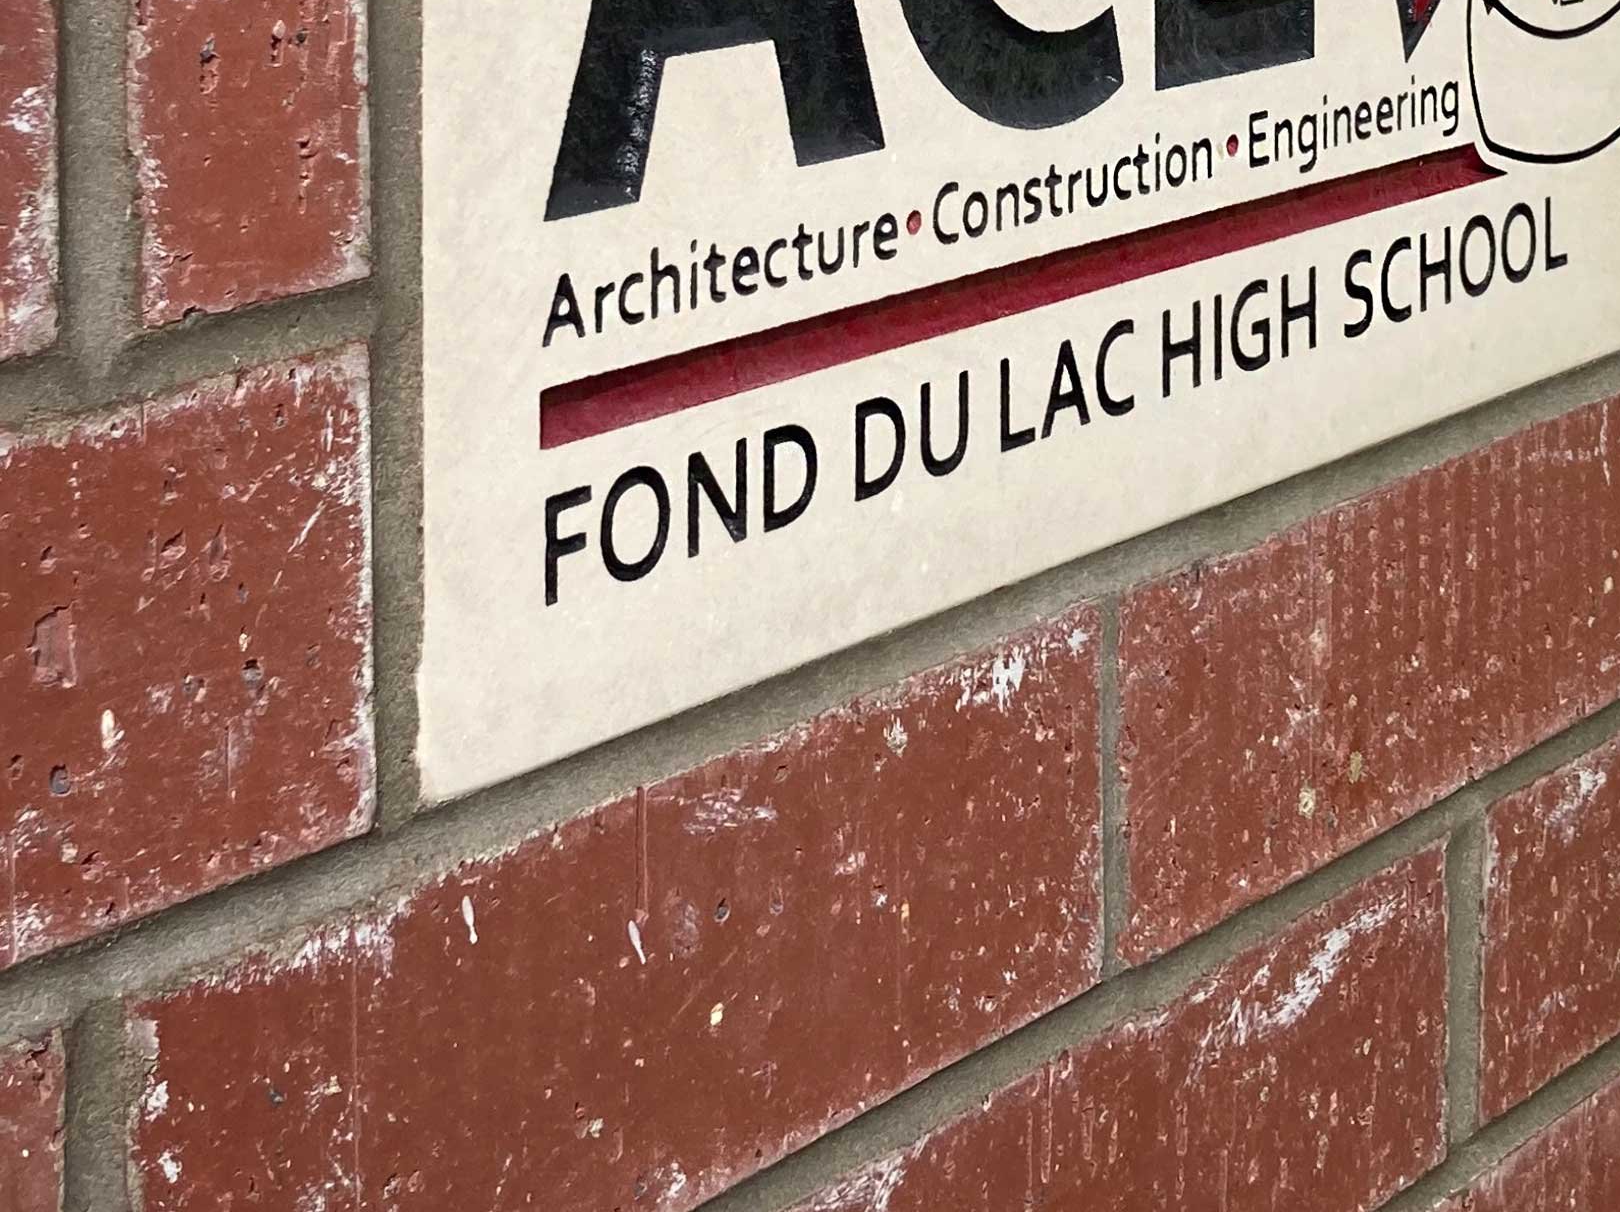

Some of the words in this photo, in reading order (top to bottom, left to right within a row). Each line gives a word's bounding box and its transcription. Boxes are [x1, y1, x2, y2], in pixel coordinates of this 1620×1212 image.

[541, 211, 899, 348] Architecture
[931, 132, 1214, 245] Construction
[1248, 75, 1460, 173] Engineering
[544, 423, 819, 607] FOND
[853, 370, 970, 503] DU
[999, 318, 1136, 454] LAC
[1161, 265, 1318, 399] HIGH
[1342, 196, 1569, 340] SCHOOL
